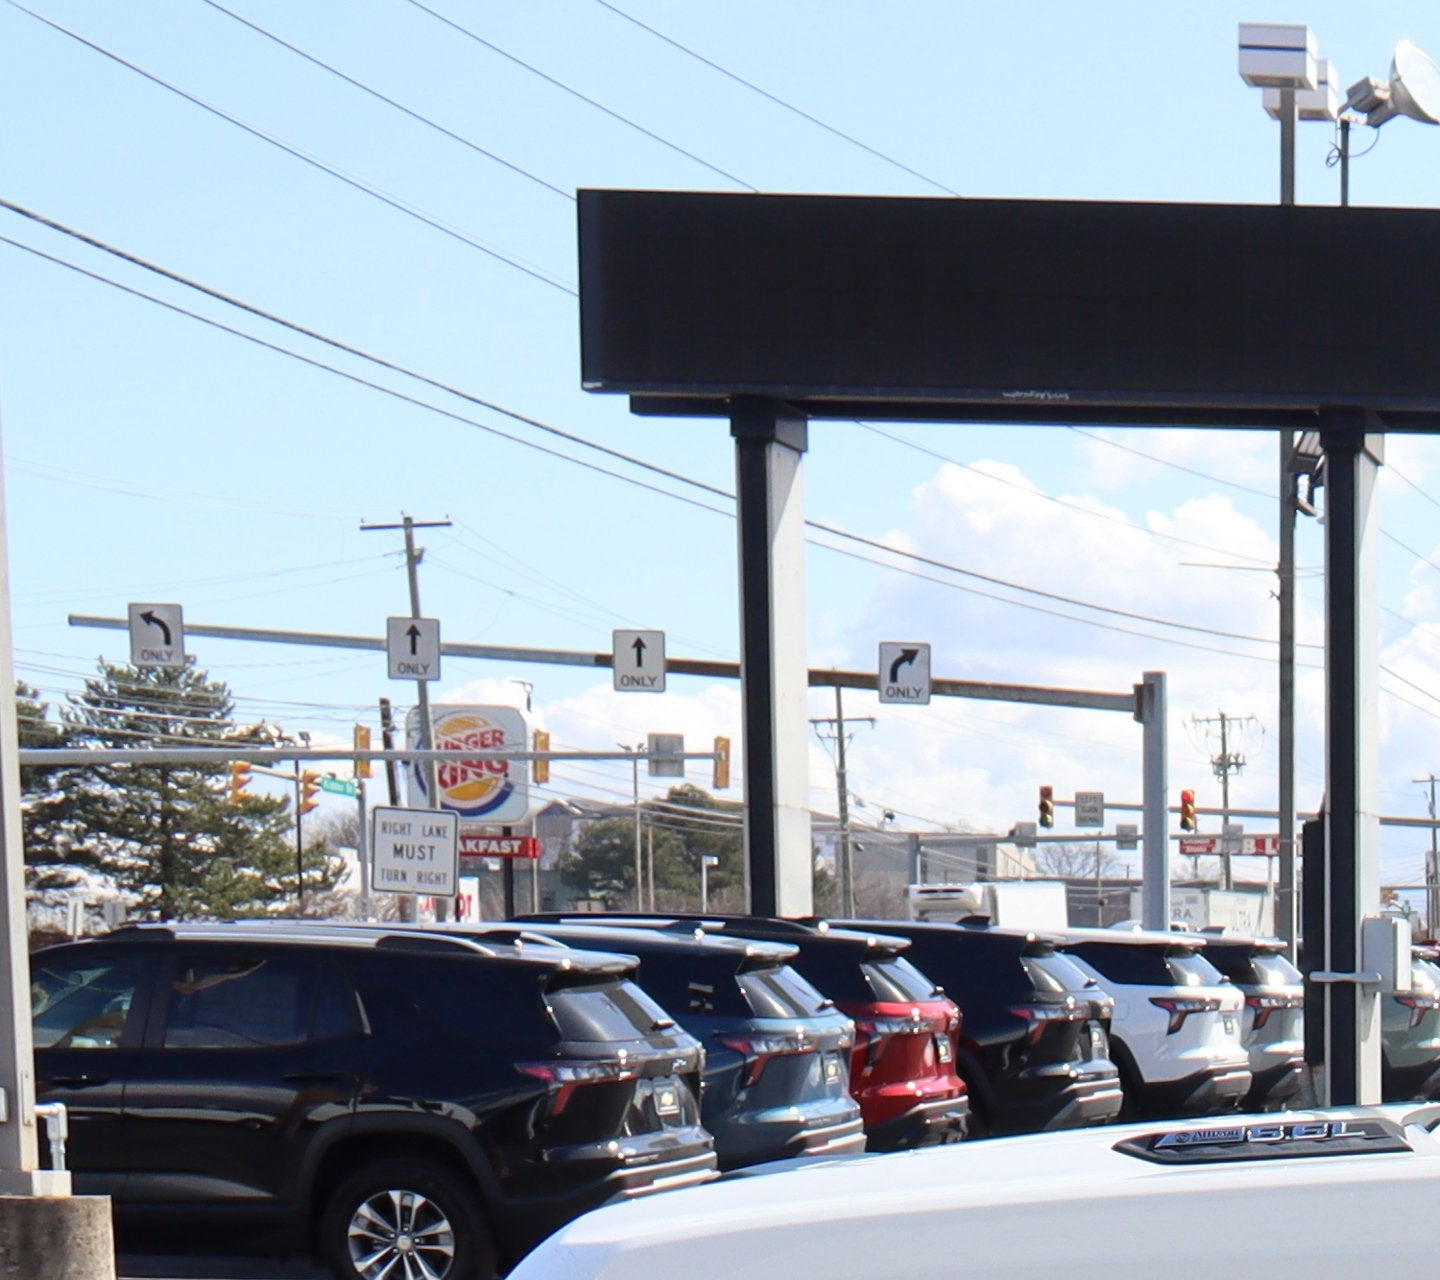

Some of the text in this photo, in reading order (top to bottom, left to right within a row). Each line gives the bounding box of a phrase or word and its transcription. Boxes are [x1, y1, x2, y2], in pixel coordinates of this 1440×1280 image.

[141, 649, 174, 663] ONLY
[397, 663, 431, 676] ONLY
[620, 674, 657, 688] ONLY
[885, 685, 923, 699] ONLY
[380, 821, 448, 839] RIGHT LANE
[393, 844, 436, 862] MUST
[458, 839, 523, 854] AKFAST
[380, 869, 447, 886] TURN RIGHT
